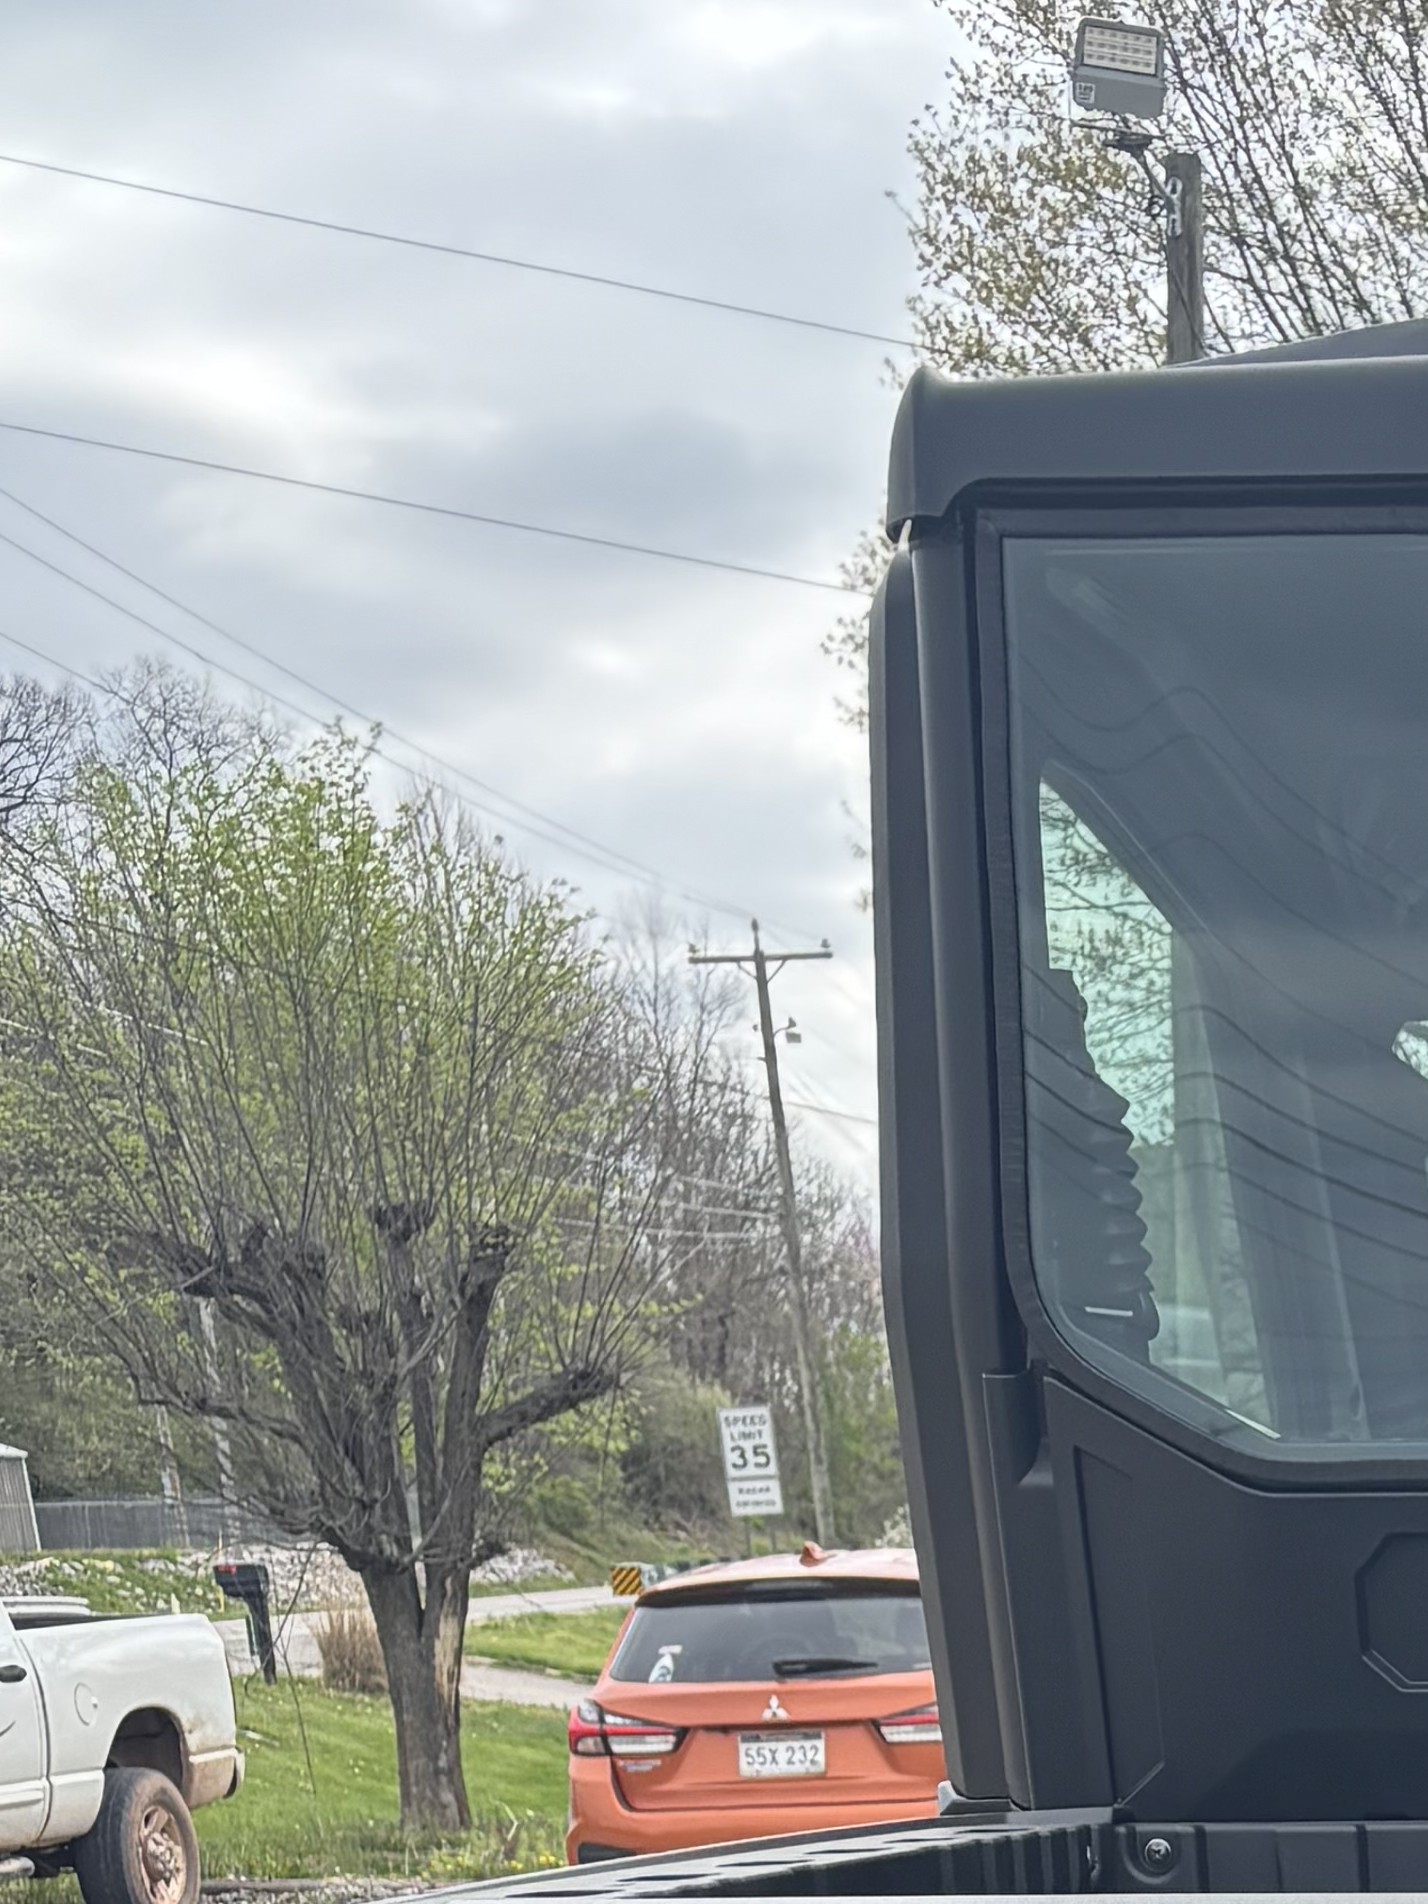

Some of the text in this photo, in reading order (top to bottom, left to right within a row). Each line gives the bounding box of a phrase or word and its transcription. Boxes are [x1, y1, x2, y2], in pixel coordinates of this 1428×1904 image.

[724, 1414, 767, 1427] SPEED
[730, 1430, 763, 1442] LIMIT
[730, 1443, 771, 1471] 35
